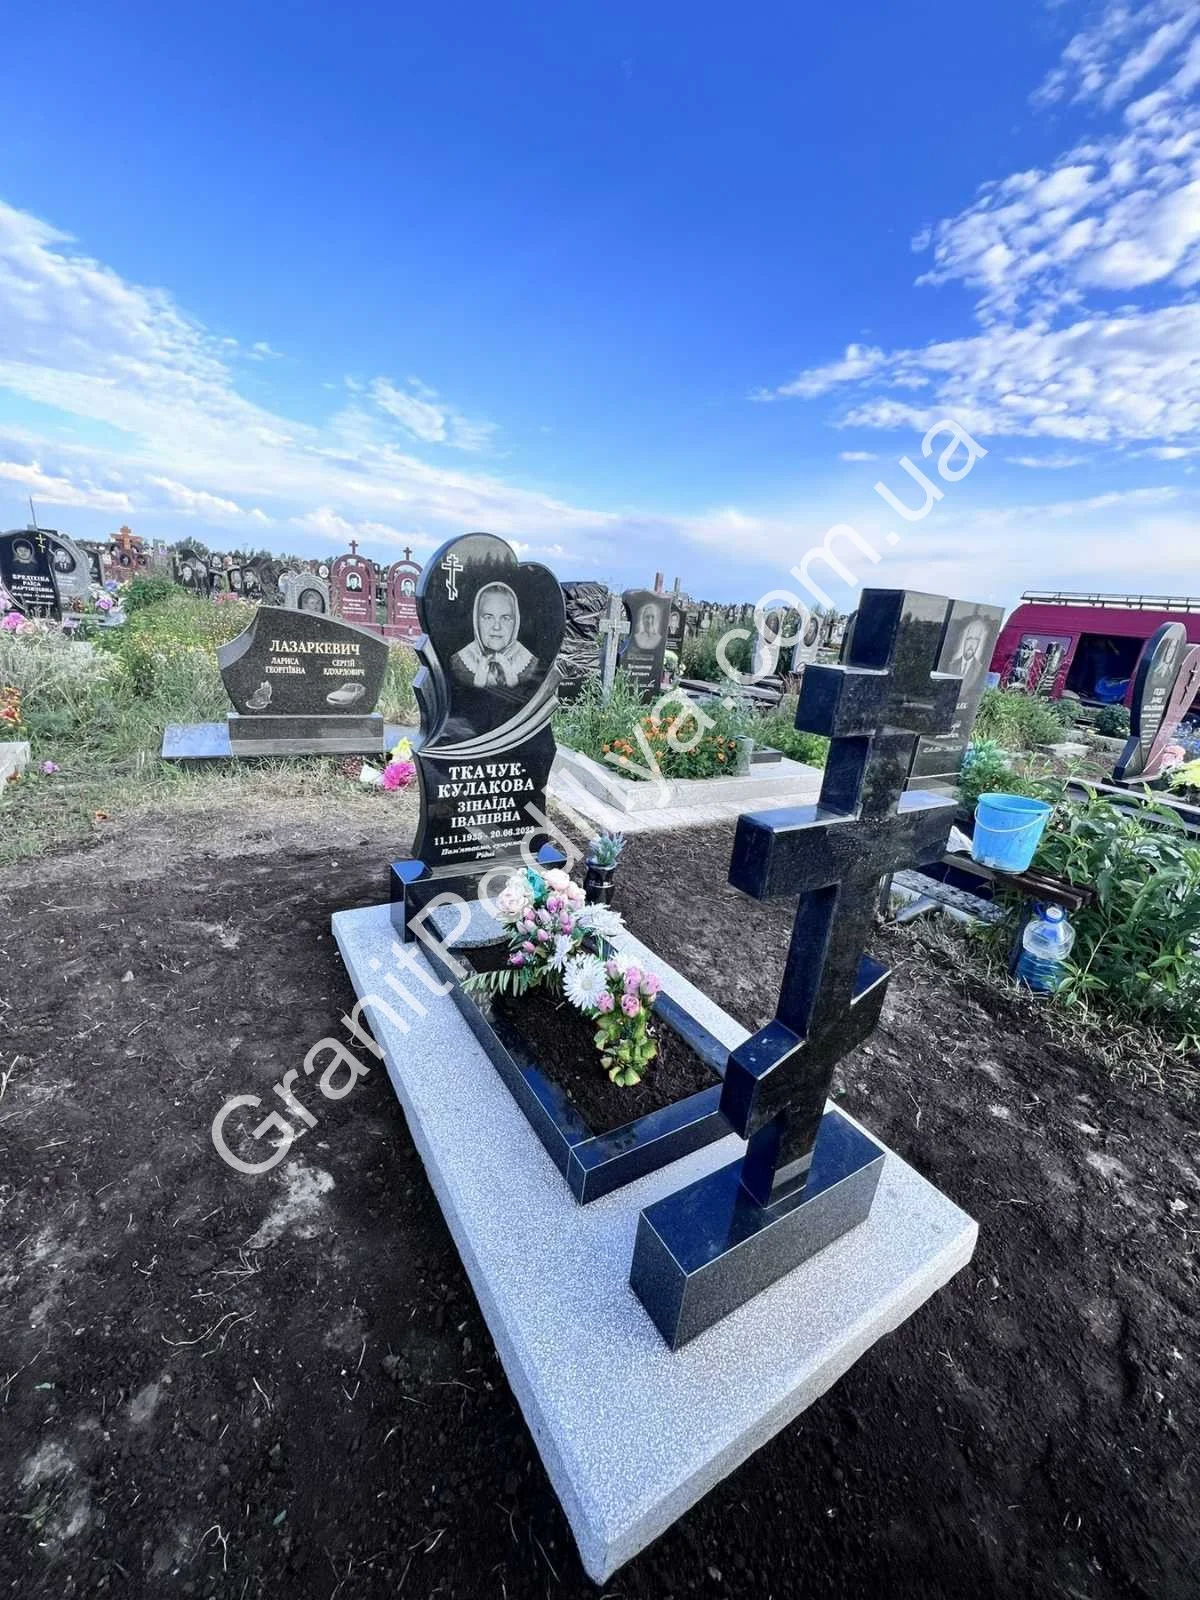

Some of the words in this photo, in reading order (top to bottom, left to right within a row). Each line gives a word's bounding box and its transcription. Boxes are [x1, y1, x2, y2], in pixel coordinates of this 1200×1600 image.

[269, 639, 360, 655] ЛАЗАРКЕВИЧ
[270, 657, 299, 665] ЛАРИСА
[332, 659, 355, 667] СЕРГІЙ
[265, 665, 306, 674] ГЕОРГІЇВНА
[449, 763, 526, 780] ТКАЧУК-
[437, 778, 535, 798] КУЛАКОВА
[458, 797, 516, 813] ЗІНАЇДА
[451, 811, 521, 828] ІВАНІВНА
